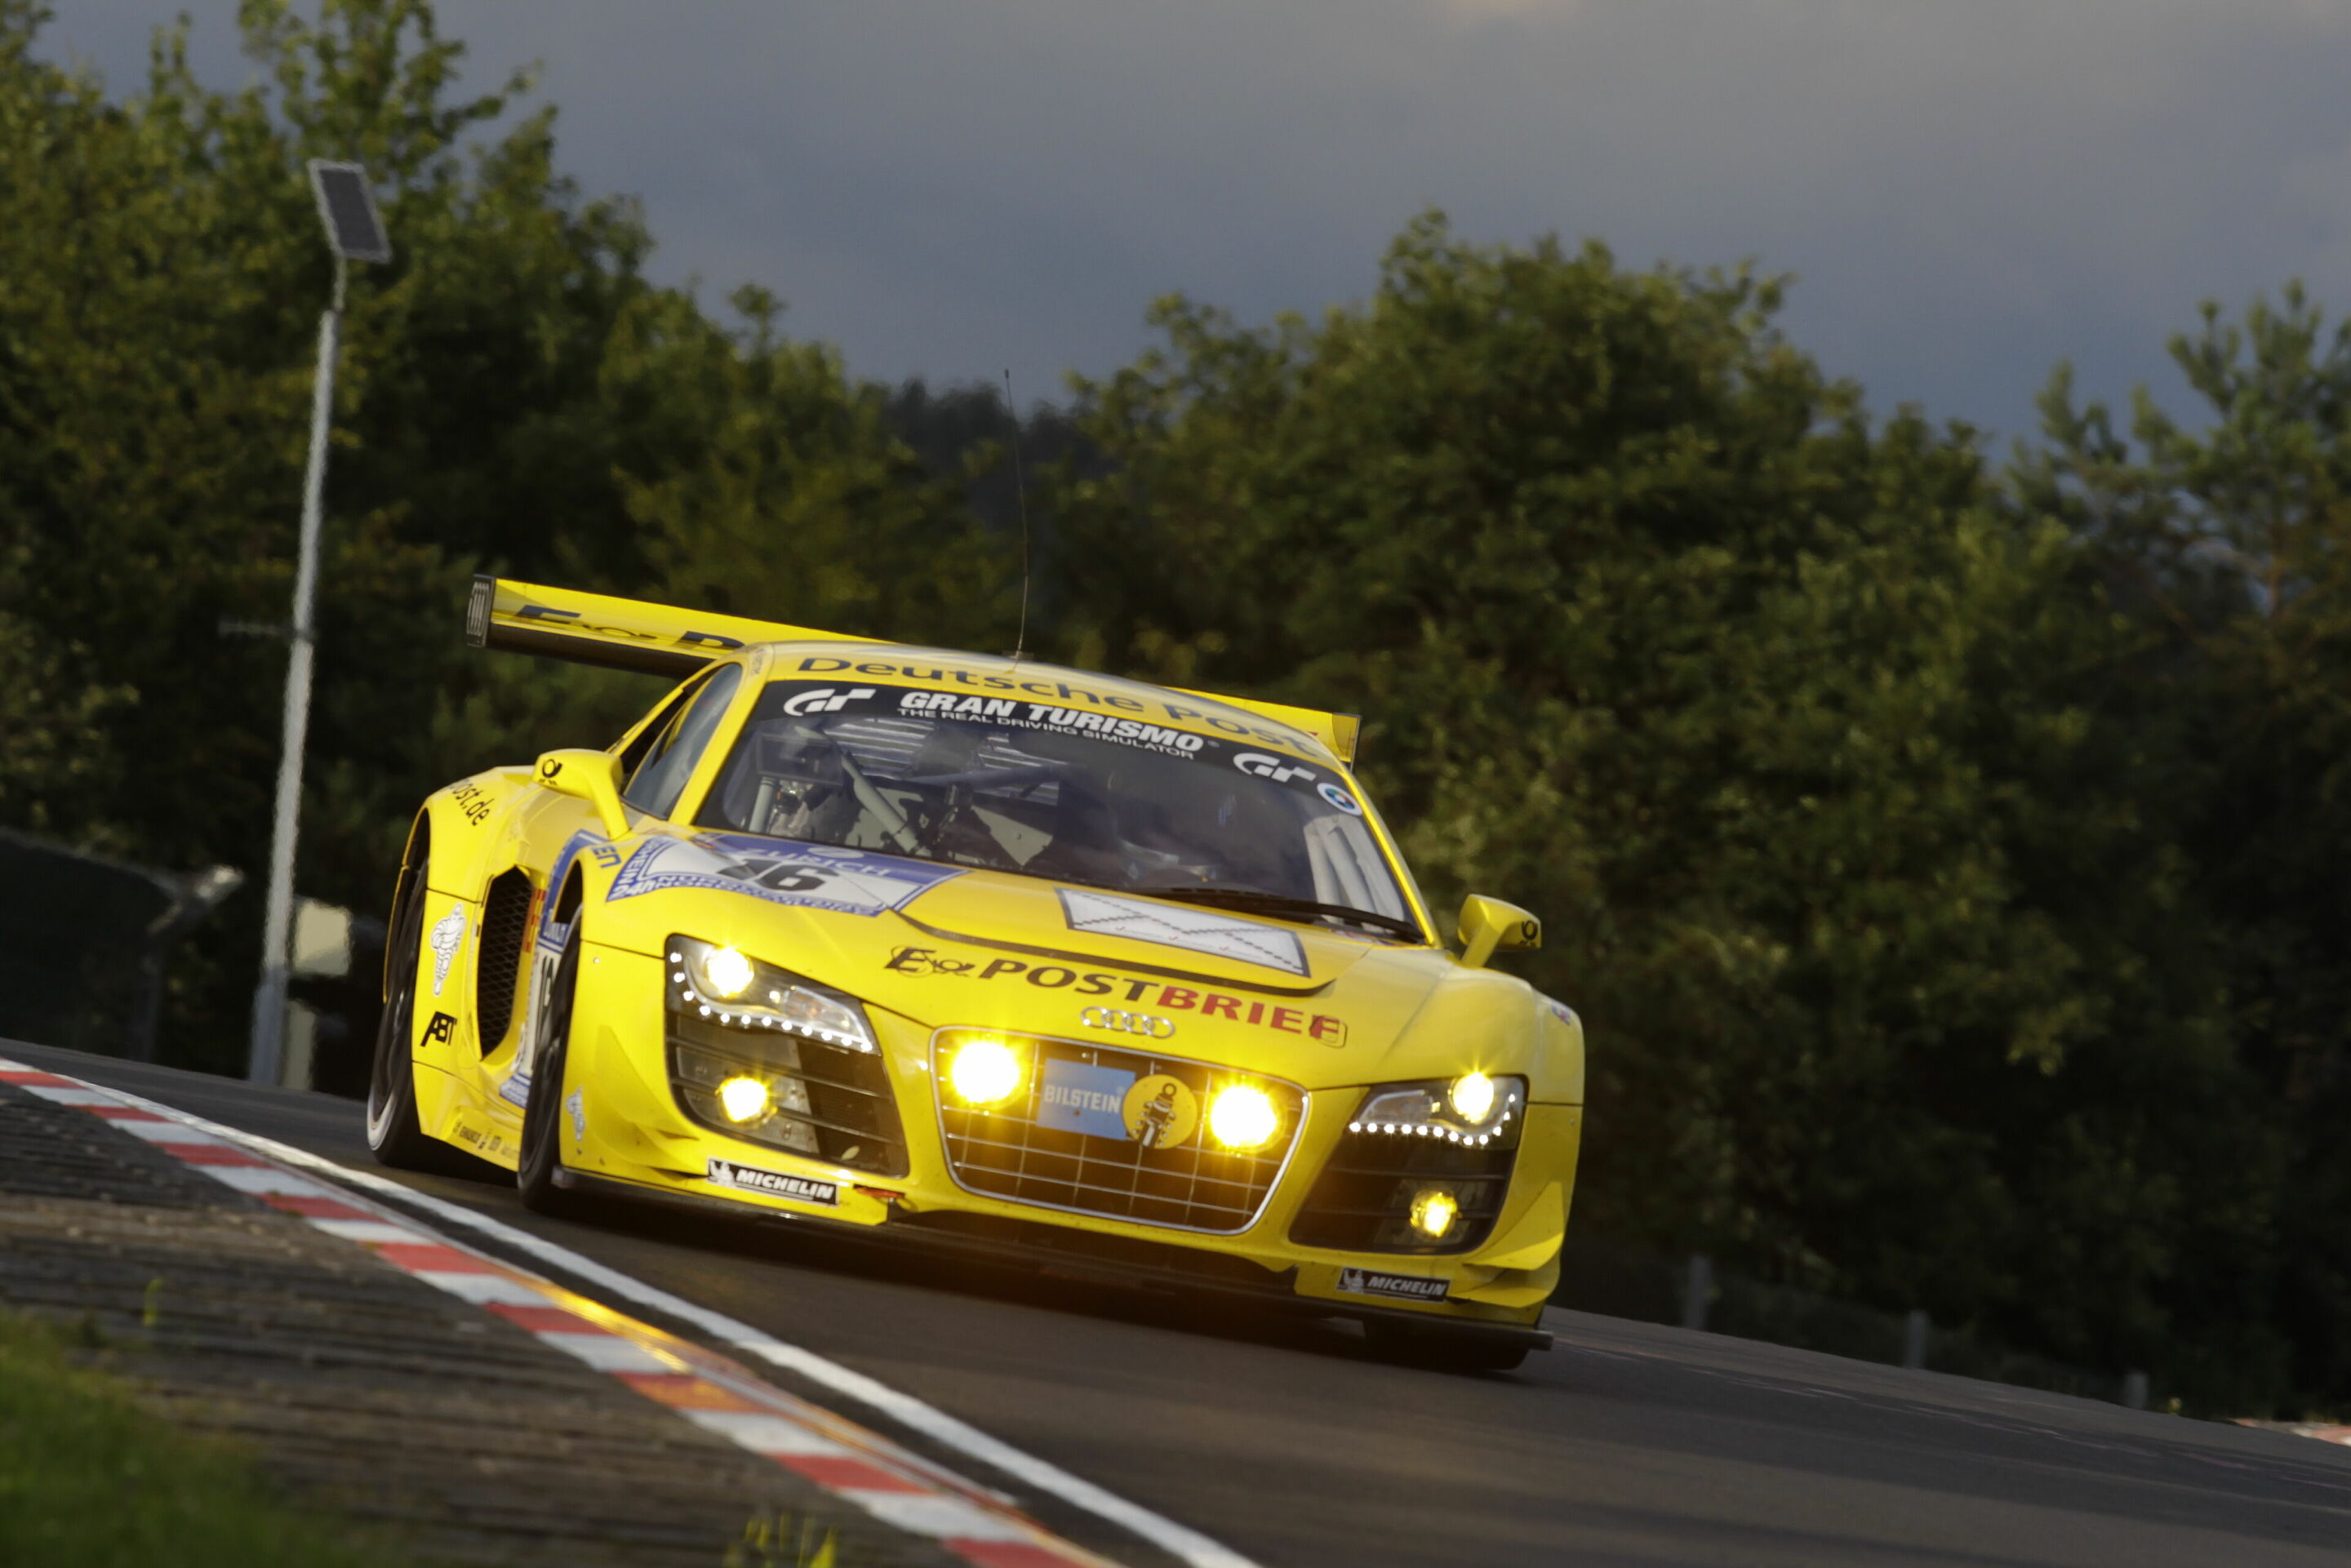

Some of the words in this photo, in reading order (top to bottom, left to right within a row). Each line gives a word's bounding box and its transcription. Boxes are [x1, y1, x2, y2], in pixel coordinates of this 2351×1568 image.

[798, 658, 1144, 712] Deutsche
[1162, 704, 1318, 757] Post
[899, 691, 1017, 717] GRAN
[1028, 704, 1204, 752] TURISMO
[897, 707, 936, 718] THE
[940, 712, 993, 725] REAL
[995, 717, 1078, 735] DRIVING
[1082, 729, 1194, 760] SIMULATOR
[978, 958, 1340, 1041] POSTBRIEF
[420, 1011, 458, 1047] ABT
[1043, 1084, 1122, 1114] BILSTEIN
[736, 1168, 835, 1200] MICHELIN
[1367, 1276, 1447, 1296] MICHELIN
